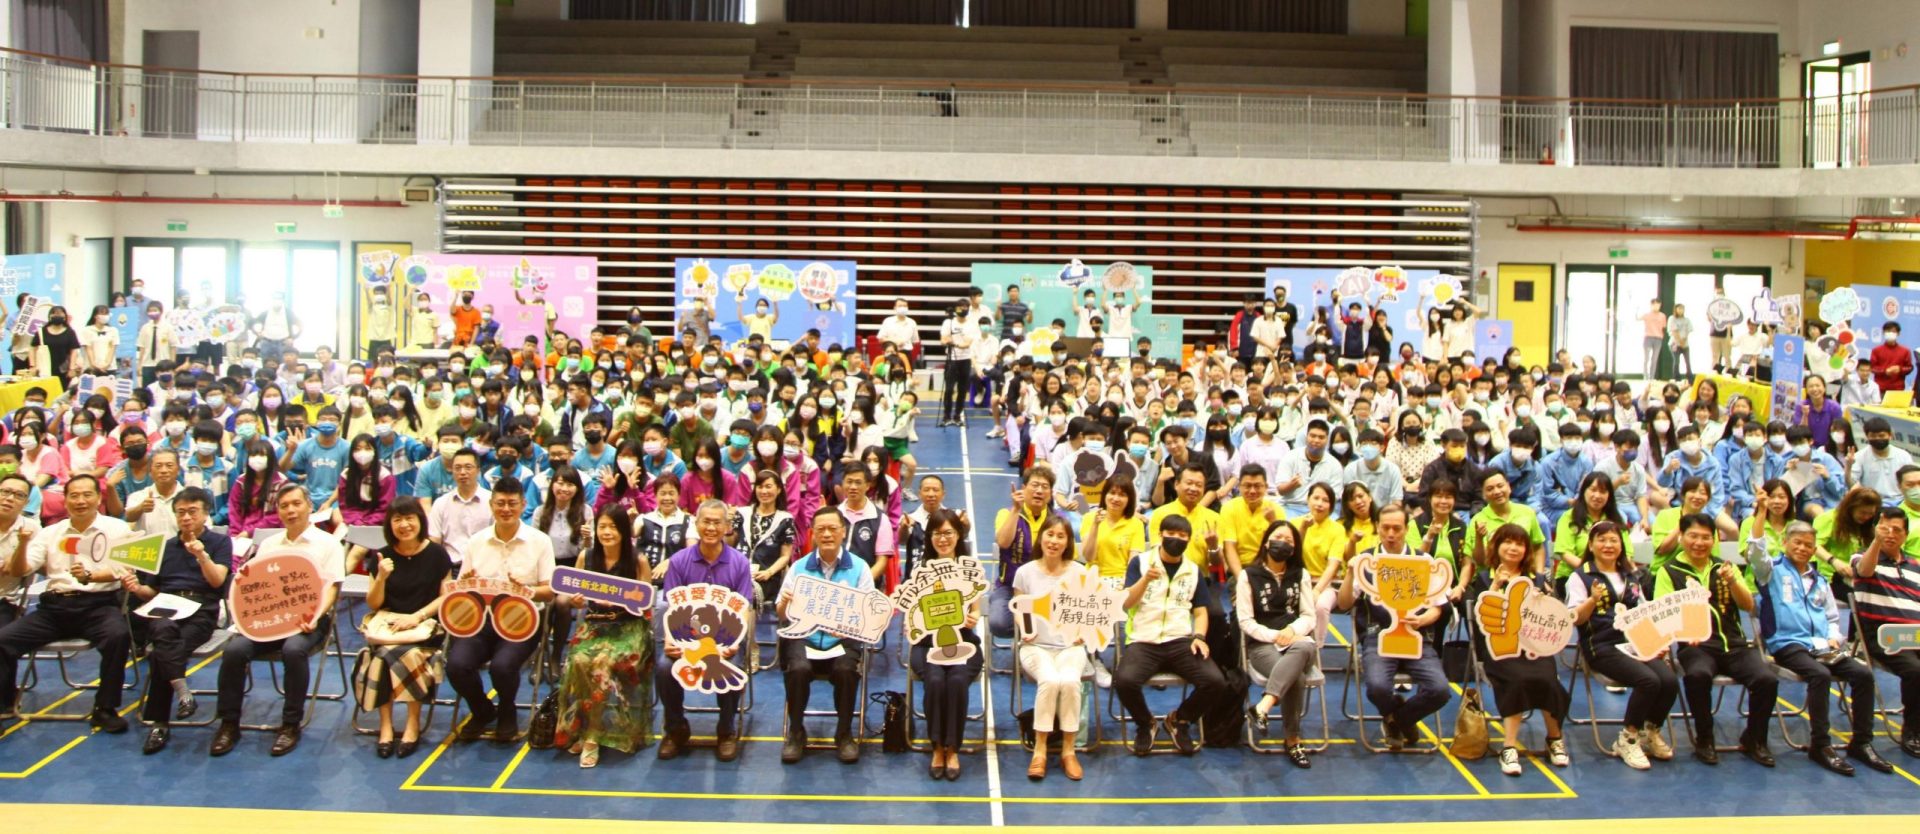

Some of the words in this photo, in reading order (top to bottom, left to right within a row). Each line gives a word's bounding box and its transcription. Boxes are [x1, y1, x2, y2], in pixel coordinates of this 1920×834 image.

[893, 560, 981, 609] 前途無量
[1378, 564, 1416, 582] 新北
[670, 586, 744, 613] 我愛秀峰
[804, 598, 860, 626] 展現自我
[1057, 592, 1113, 610] 新北高中
[1059, 608, 1111, 626] 展現自我
[1522, 606, 1569, 631] 新北高中
